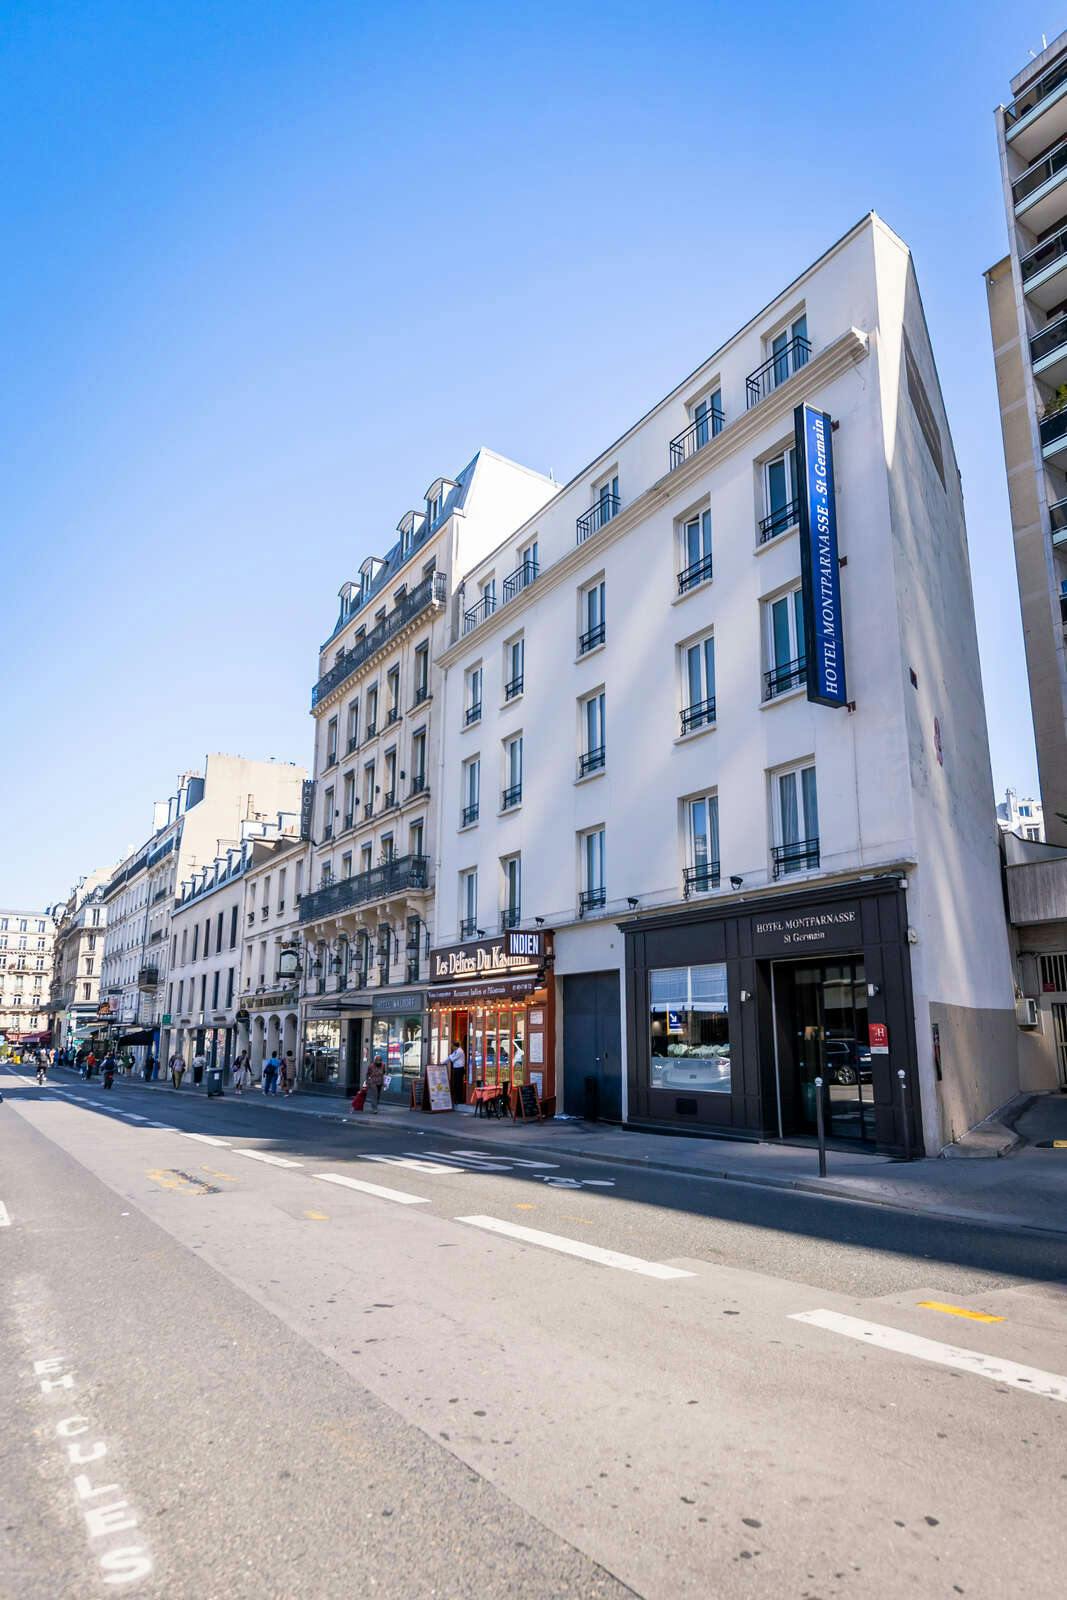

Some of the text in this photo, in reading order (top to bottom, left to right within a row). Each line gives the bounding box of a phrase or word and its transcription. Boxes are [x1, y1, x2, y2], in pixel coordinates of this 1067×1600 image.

[812, 419, 827, 477] Germain
[816, 479, 828, 496] St
[817, 505, 835, 636] MONTPARNASSE
[824, 641, 838, 694] HOTEL
[756, 911, 856, 933] HOTEL MONTPARNASSE
[510, 933, 539, 955] INDIEN
[783, 930, 825, 944] St Germain
[436, 955, 448, 976] Les
[449, 951, 477, 974] Délices
[477, 948, 492, 970] Du
[357, 1151, 560, 1175] BUS
